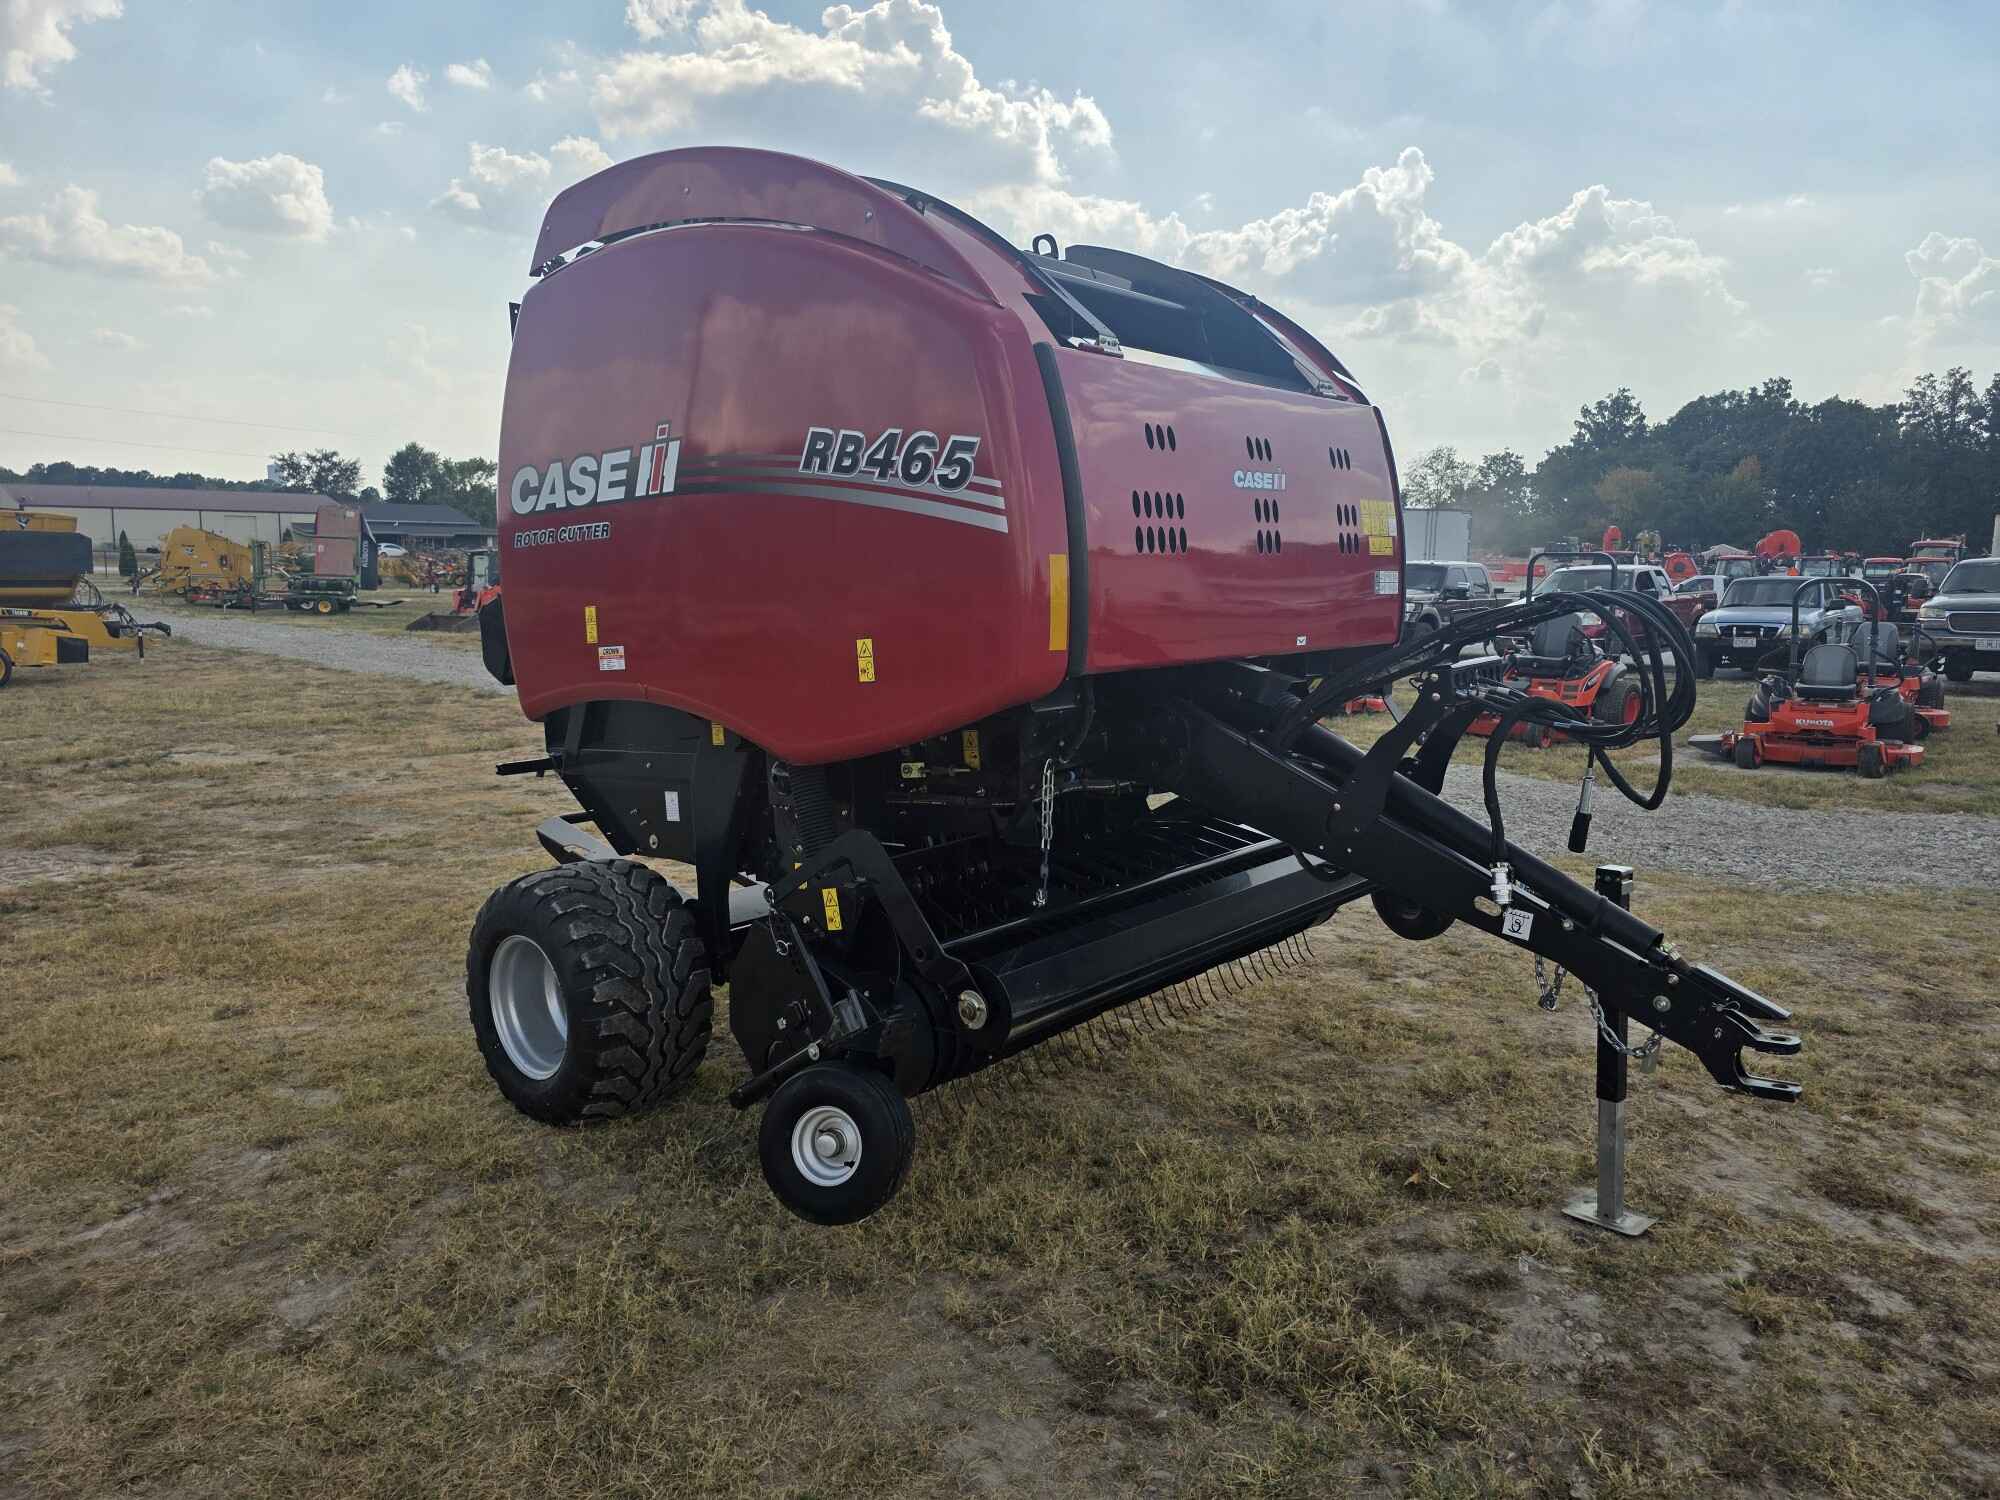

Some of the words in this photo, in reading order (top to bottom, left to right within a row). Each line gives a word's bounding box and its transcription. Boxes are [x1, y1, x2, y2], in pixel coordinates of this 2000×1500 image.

[798, 426, 981, 493] RB465
[511, 449, 631, 514] CASE
[1233, 470, 1273, 489] CASE
[513, 529, 556, 549] ROTOR
[558, 521, 611, 543] CUTTER
[1794, 718, 1834, 727] KUBOTA
